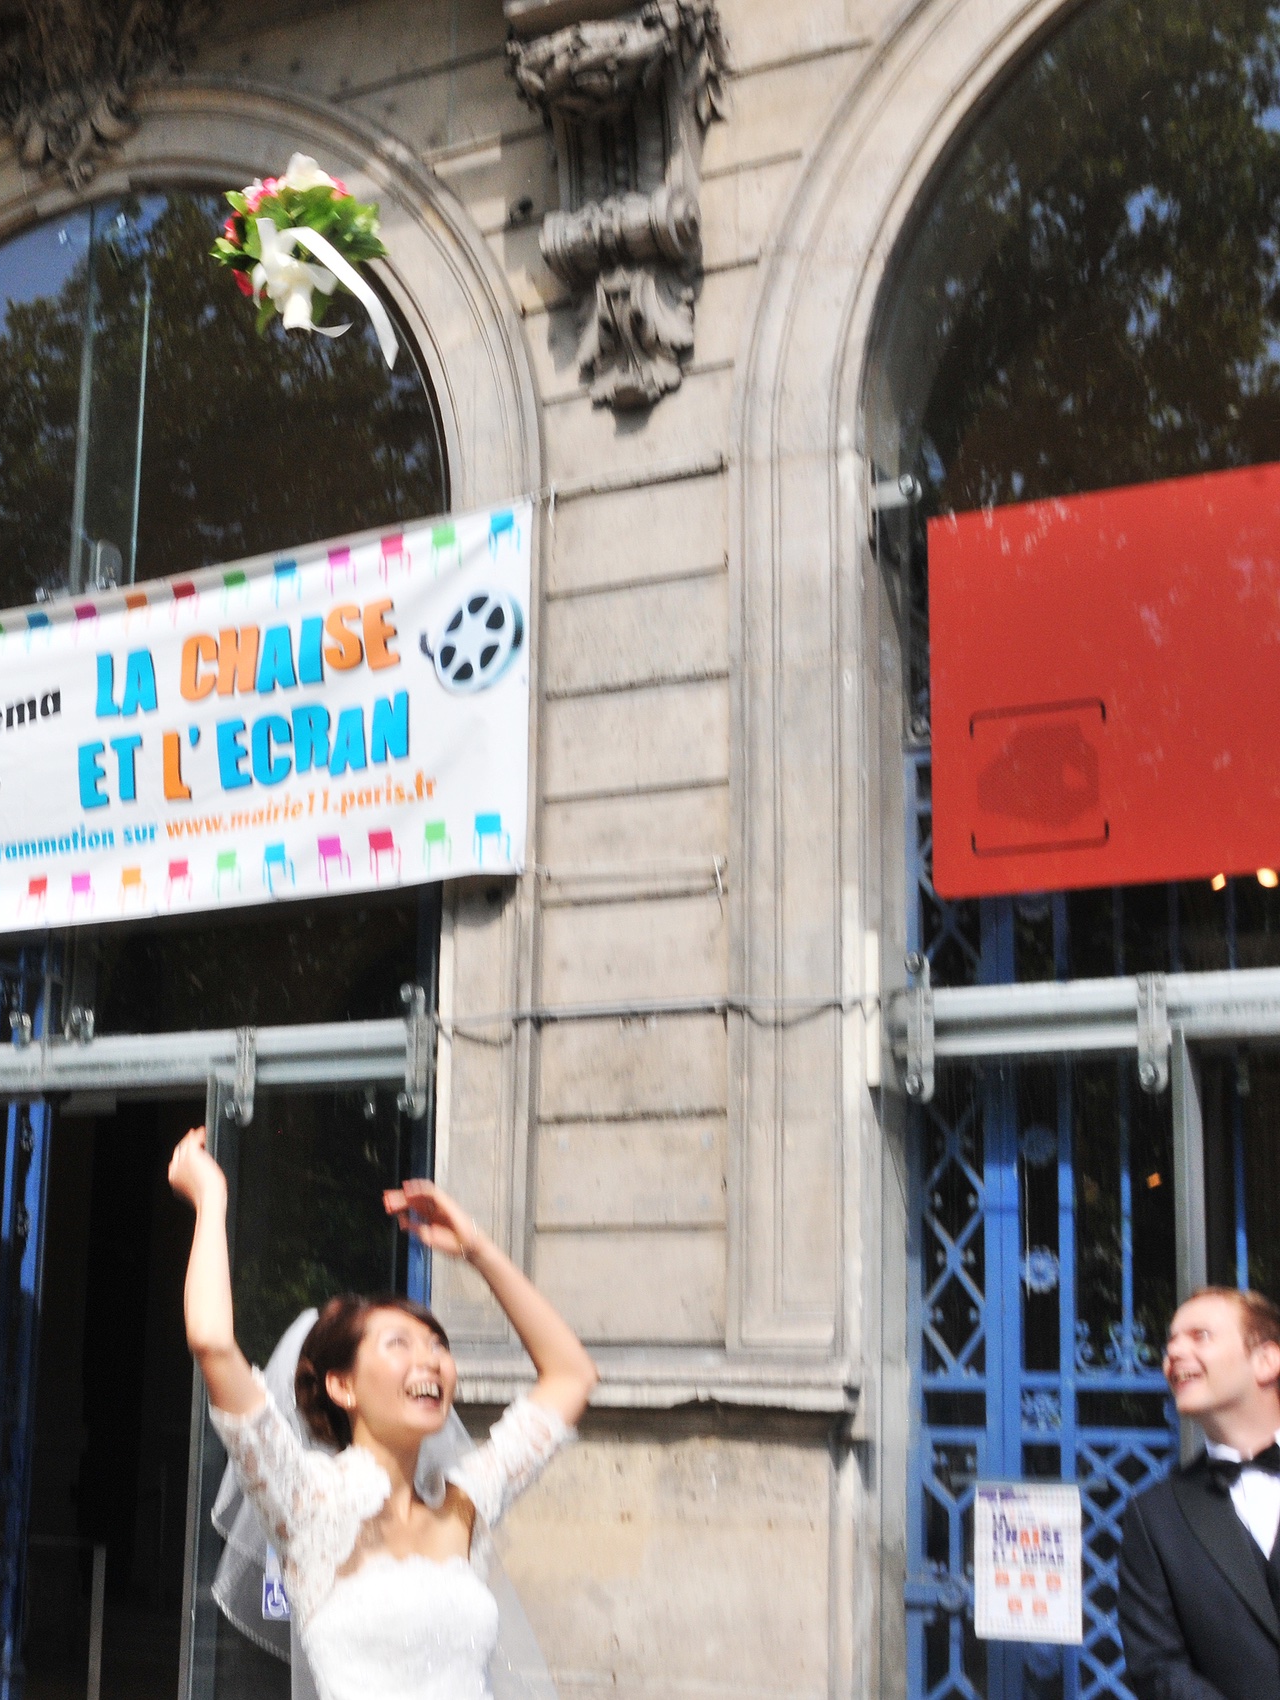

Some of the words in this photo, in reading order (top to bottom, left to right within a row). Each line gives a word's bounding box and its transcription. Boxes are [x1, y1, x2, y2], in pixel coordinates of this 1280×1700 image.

[96, 648, 158, 717] LA
[179, 599, 402, 701] CHAISE
[77, 734, 143, 808] ET
[123, 822, 159, 845] sur
[165, 769, 437, 839] www.mairie11.paris.fr
